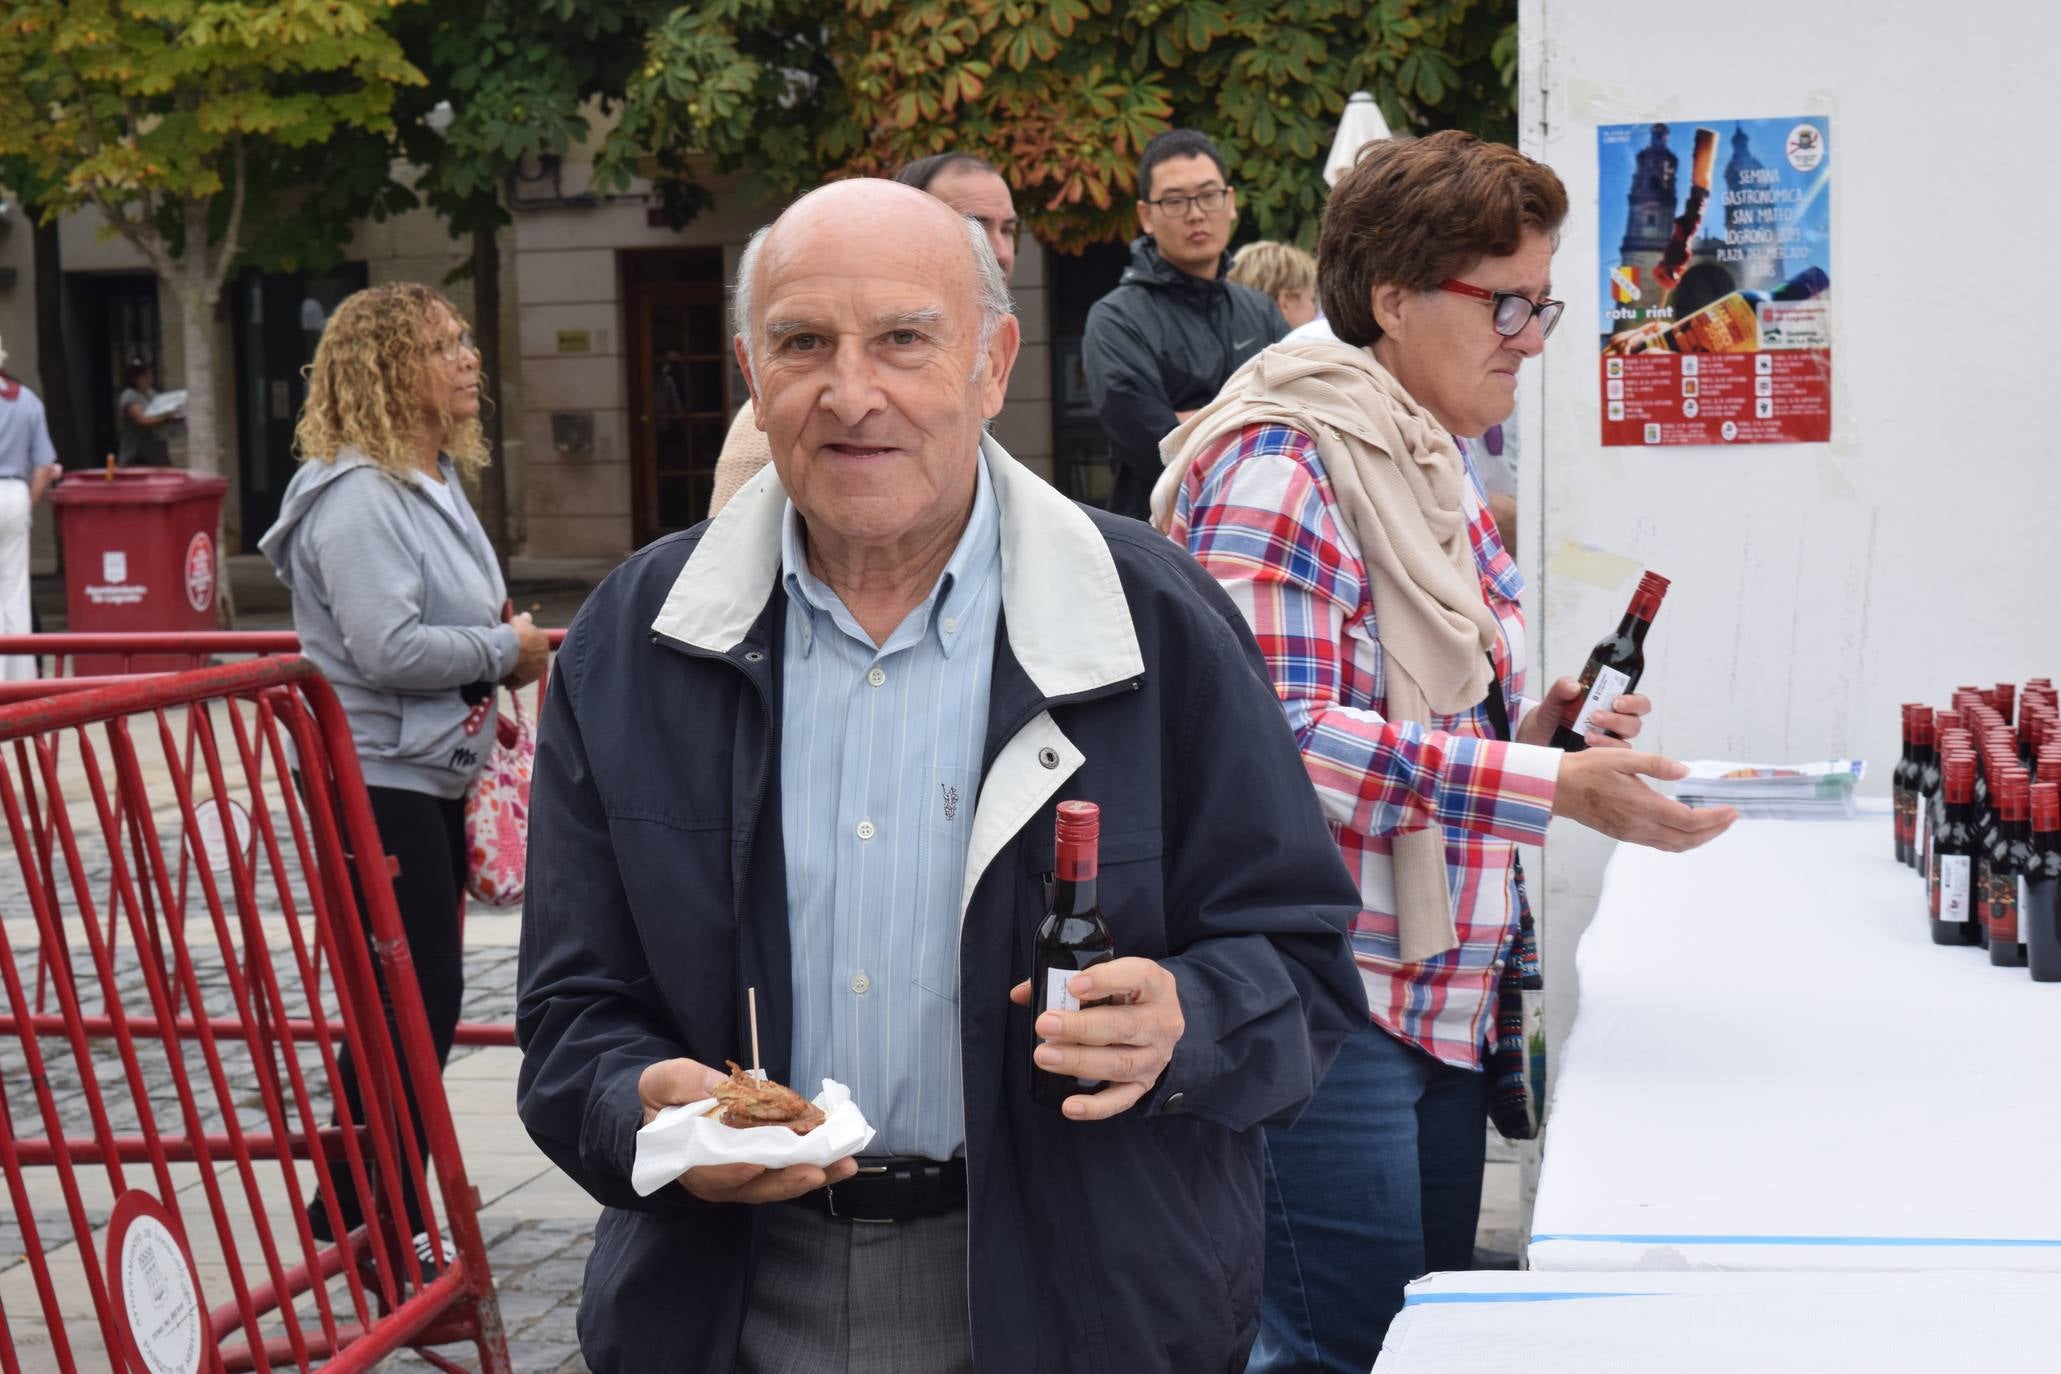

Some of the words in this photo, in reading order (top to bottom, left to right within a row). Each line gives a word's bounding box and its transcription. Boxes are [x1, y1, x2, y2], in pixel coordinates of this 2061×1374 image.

[1739, 168, 1780, 184] SEMANA
[1732, 208, 1753, 224] SAN
[1757, 207, 1793, 222] MATEO
[1724, 226, 1773, 245] LOGROÑO
[1716, 248, 1743, 262] PLAZA
